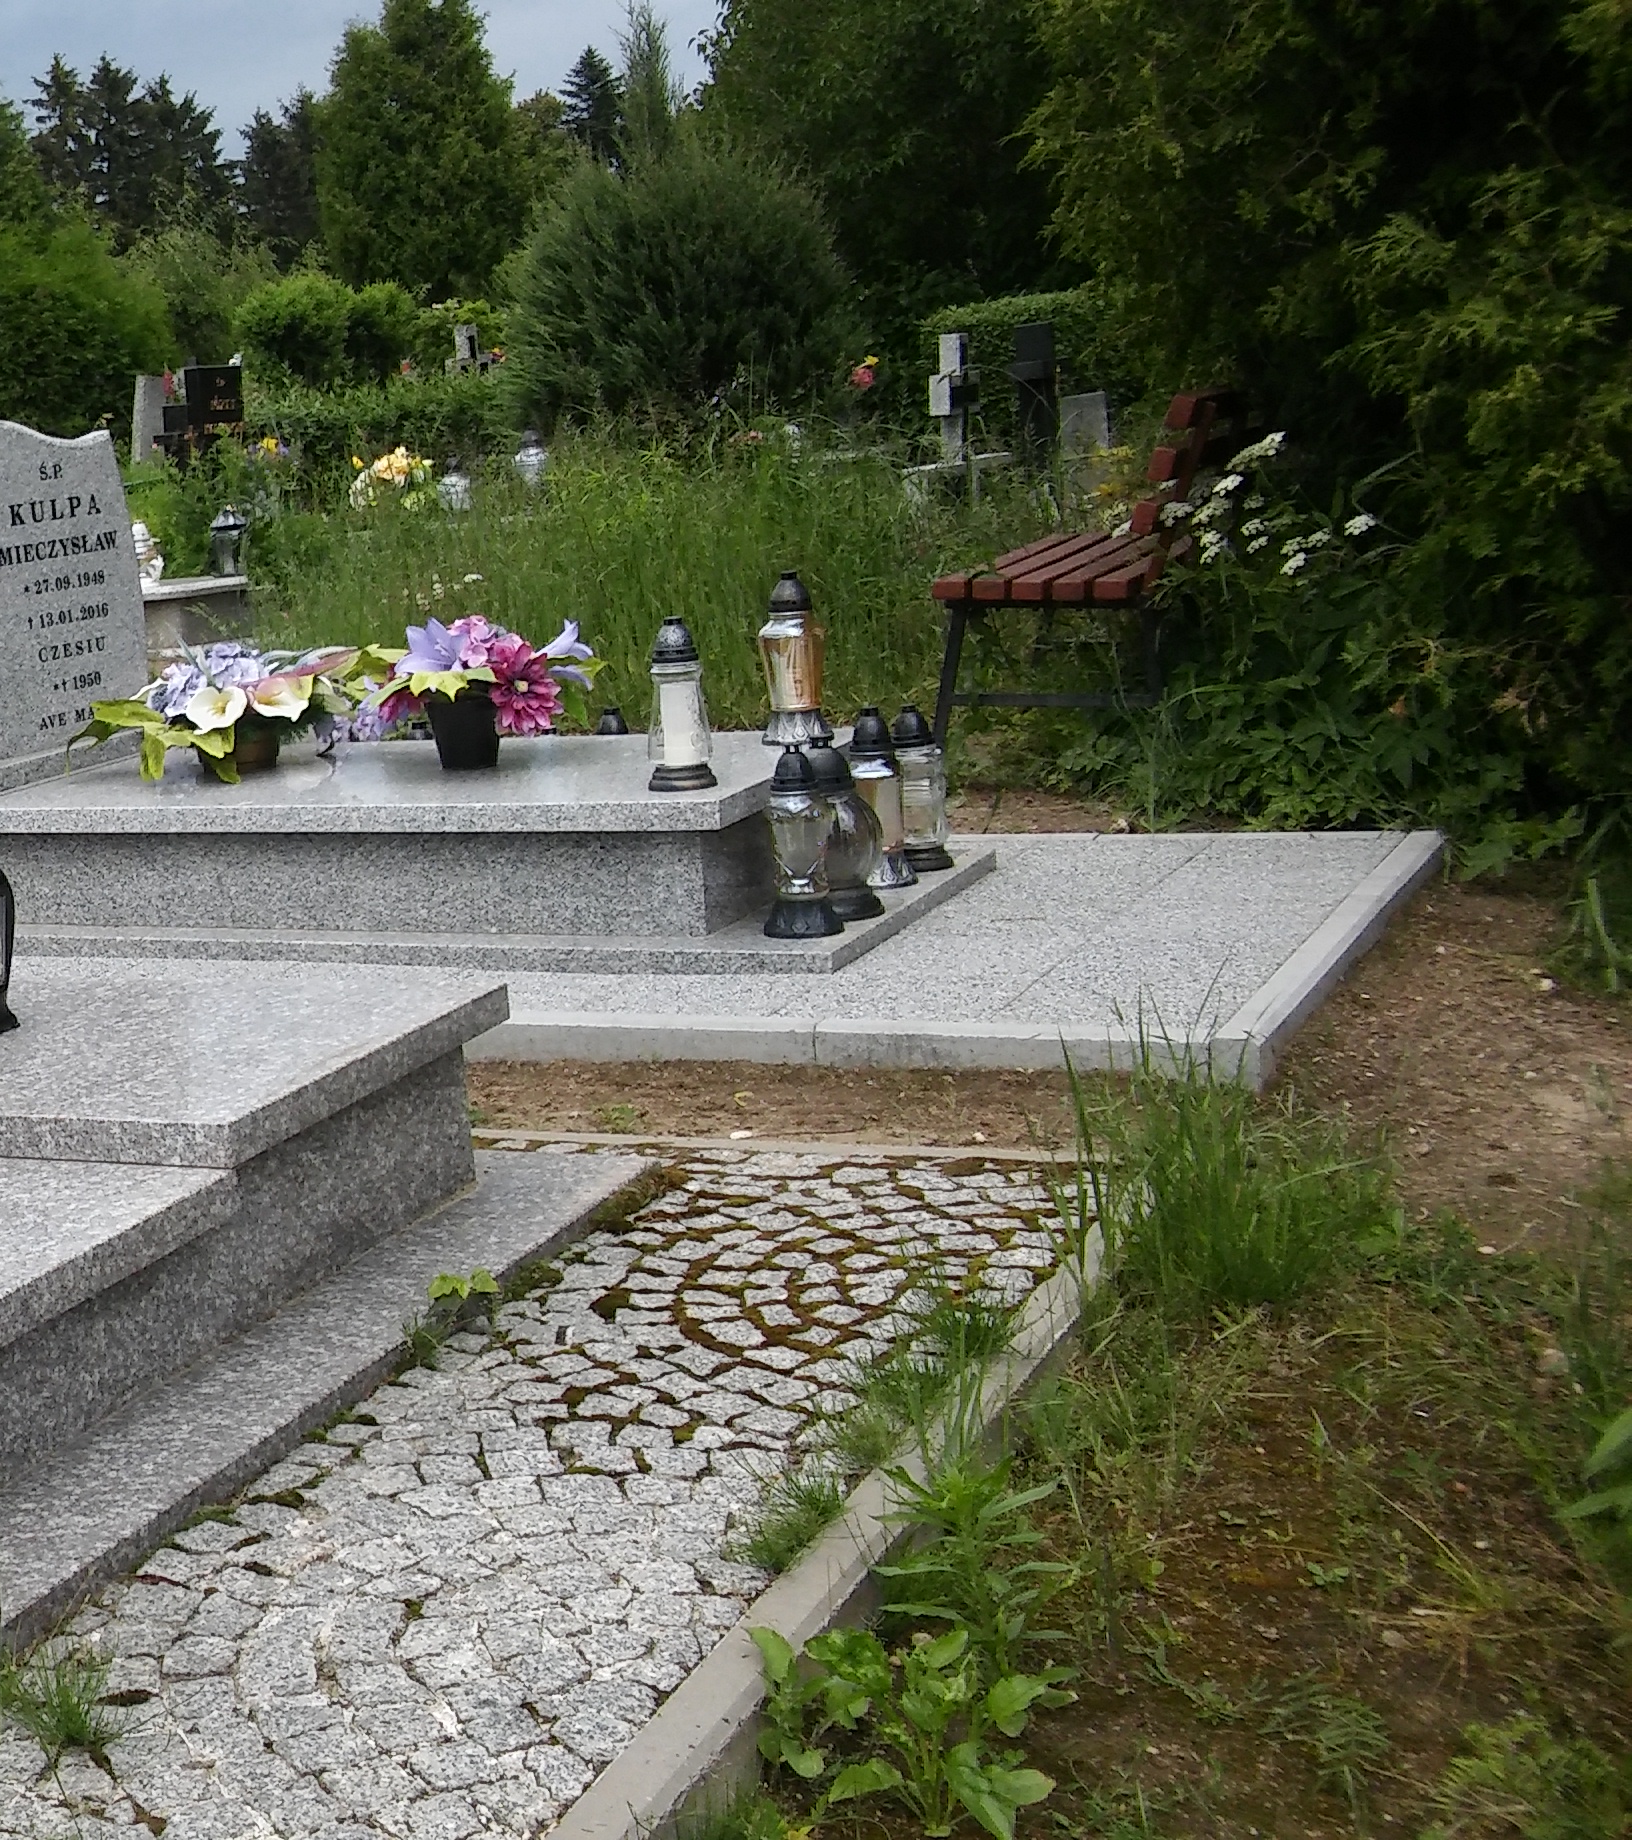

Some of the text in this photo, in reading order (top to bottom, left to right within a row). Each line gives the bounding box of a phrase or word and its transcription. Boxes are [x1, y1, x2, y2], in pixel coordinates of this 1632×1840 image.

[38, 460, 64, 482] Ś.P.
[7, 494, 102, 528] KULPA
[38, 637, 106, 663] CZESIU
[38, 712, 68, 731] AVE
